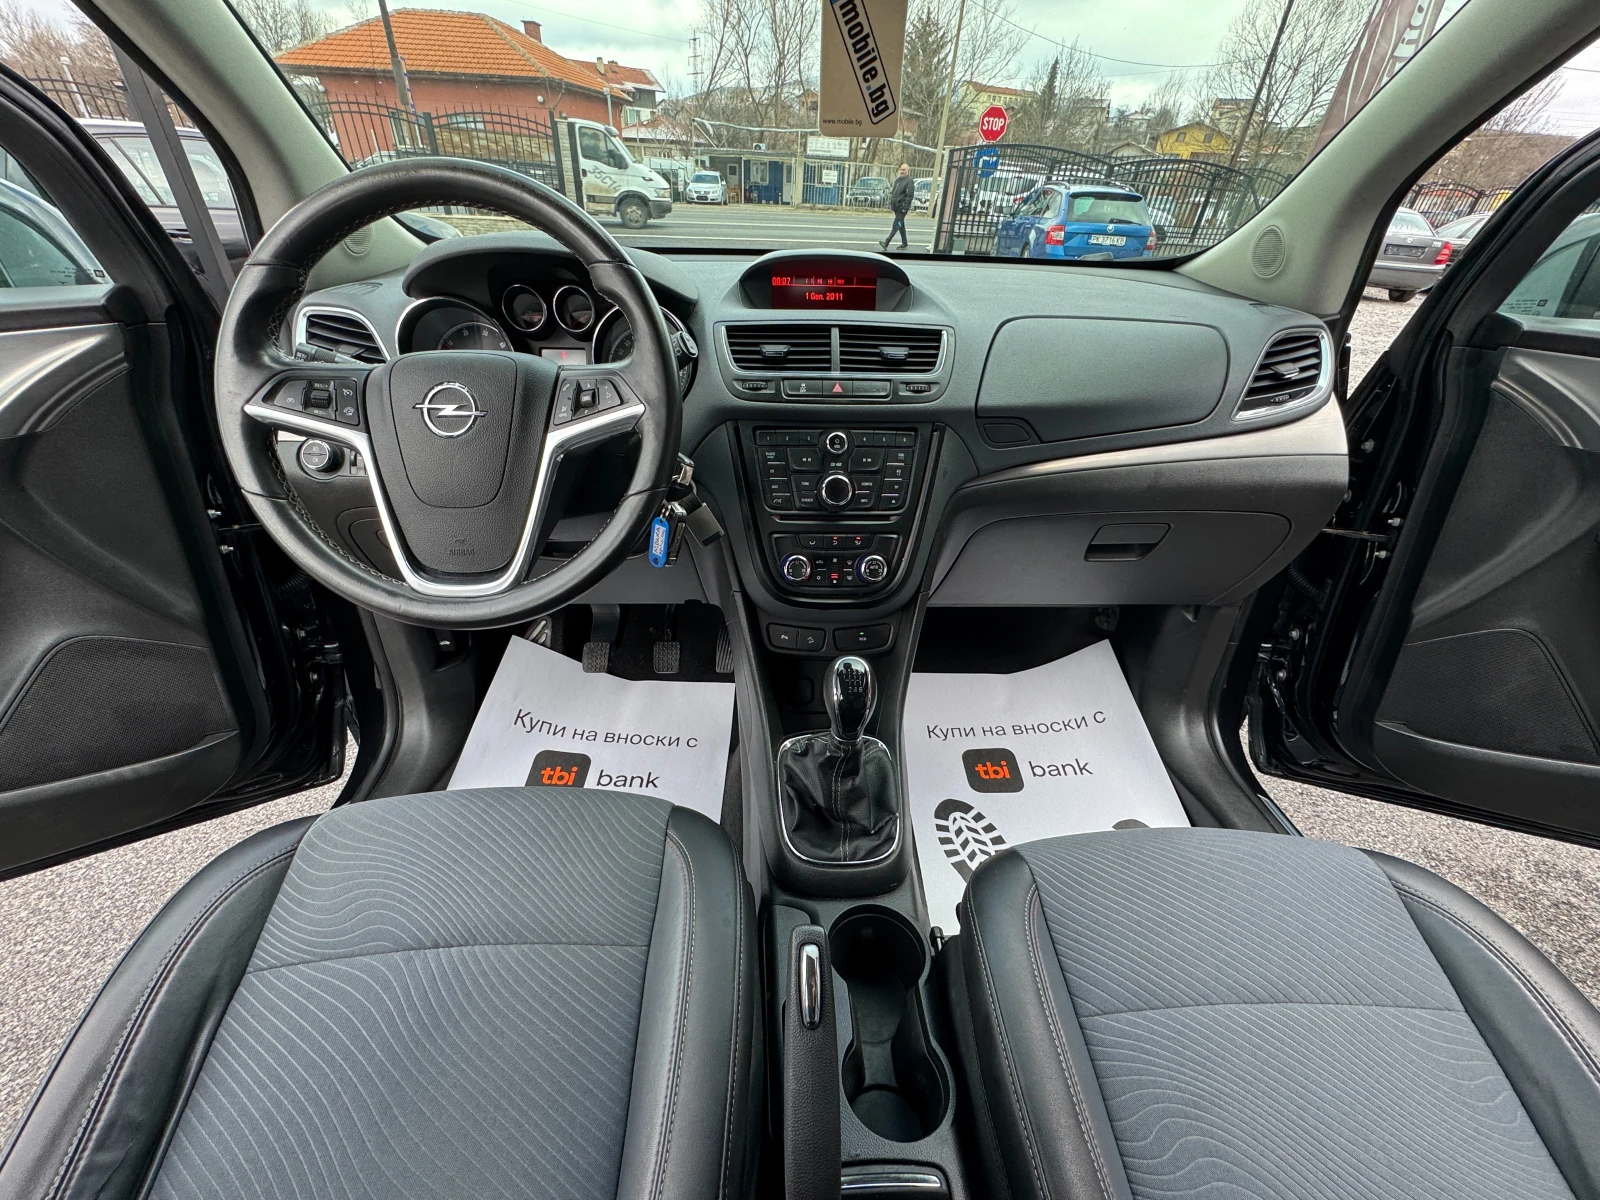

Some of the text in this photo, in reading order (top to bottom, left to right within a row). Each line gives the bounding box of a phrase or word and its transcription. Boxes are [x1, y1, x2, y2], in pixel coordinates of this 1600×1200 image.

[822, 118, 862, 126] www.mobile.bg
[982, 117, 1005, 131] STOP
[587, 165, 622, 192] 35C14
[772, 277, 791, 285] 00:07
[826, 292, 843, 301] 2011
[513, 708, 699, 749] Купи на вноски с
[926, 710, 1107, 741] Купи на вноски с
[540, 766, 660, 789] tbi bank
[974, 758, 1094, 780] tbi bank
